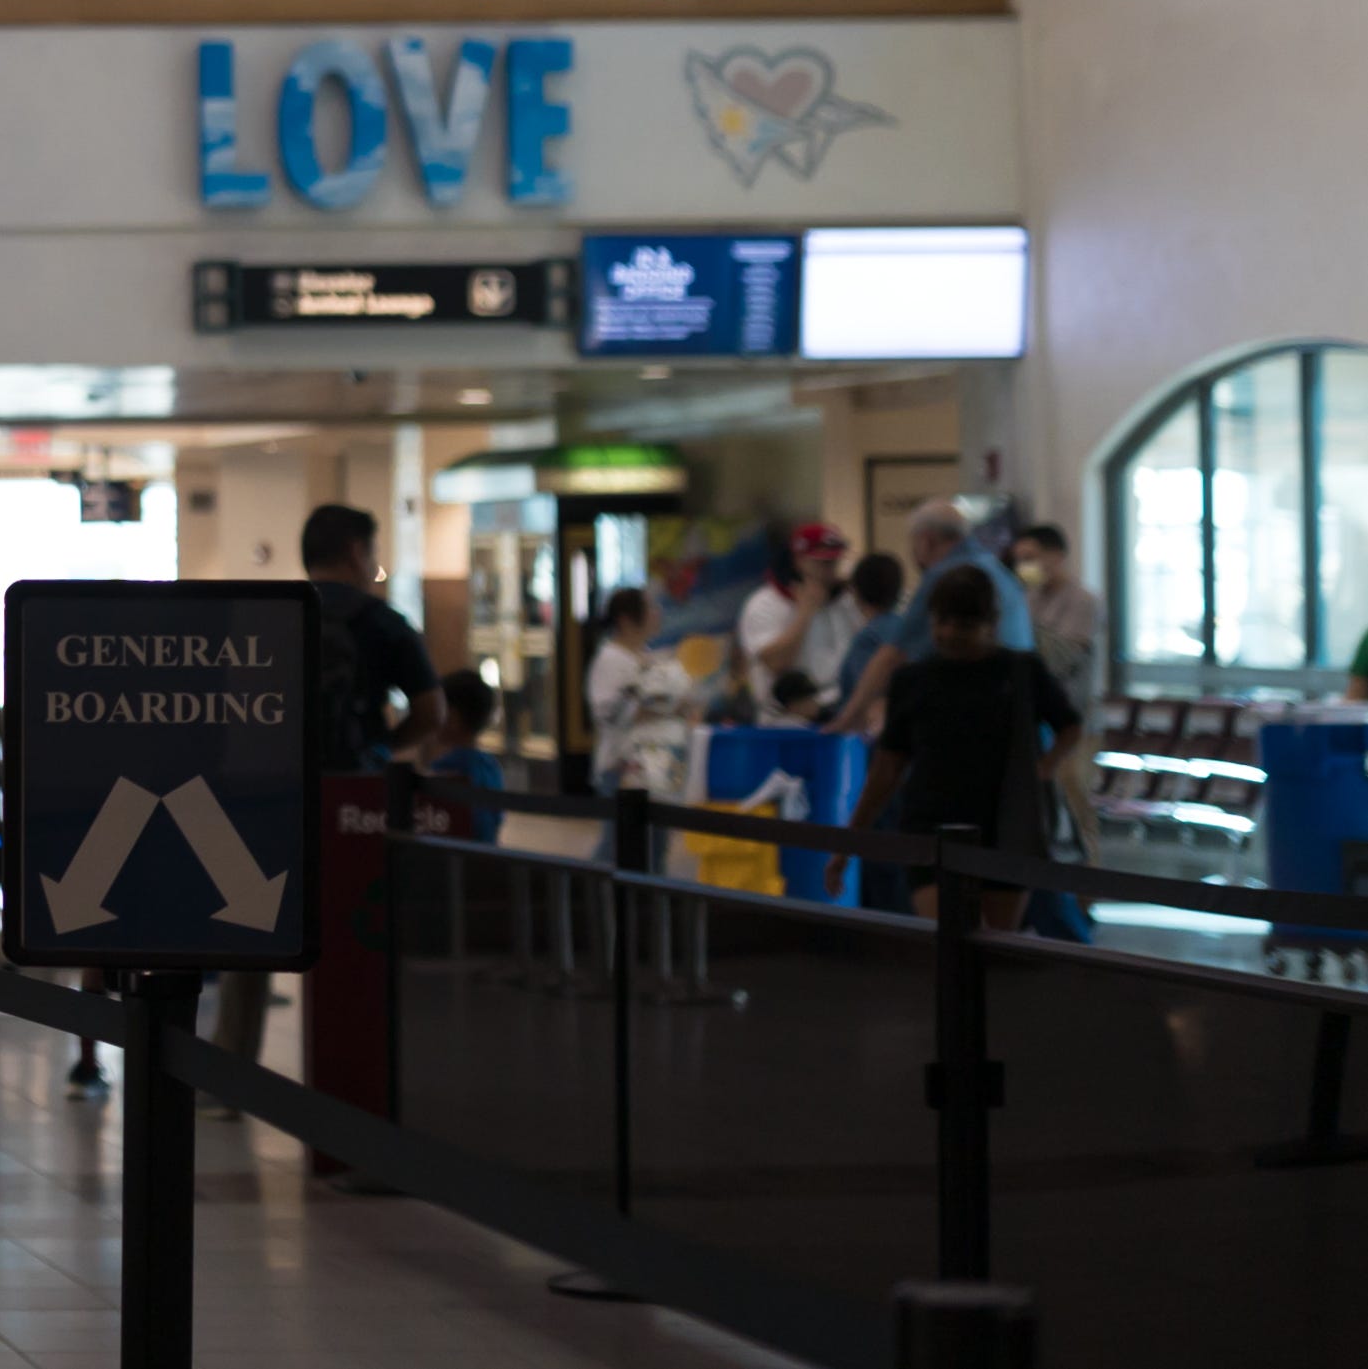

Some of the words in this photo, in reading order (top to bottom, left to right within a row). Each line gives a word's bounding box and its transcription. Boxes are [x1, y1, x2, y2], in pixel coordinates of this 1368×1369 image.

[197, 37, 575, 210] LOVE
[55, 634, 273, 669] GENERAL
[45, 690, 285, 726] BOARDING
[337, 801, 451, 836] Reccle
